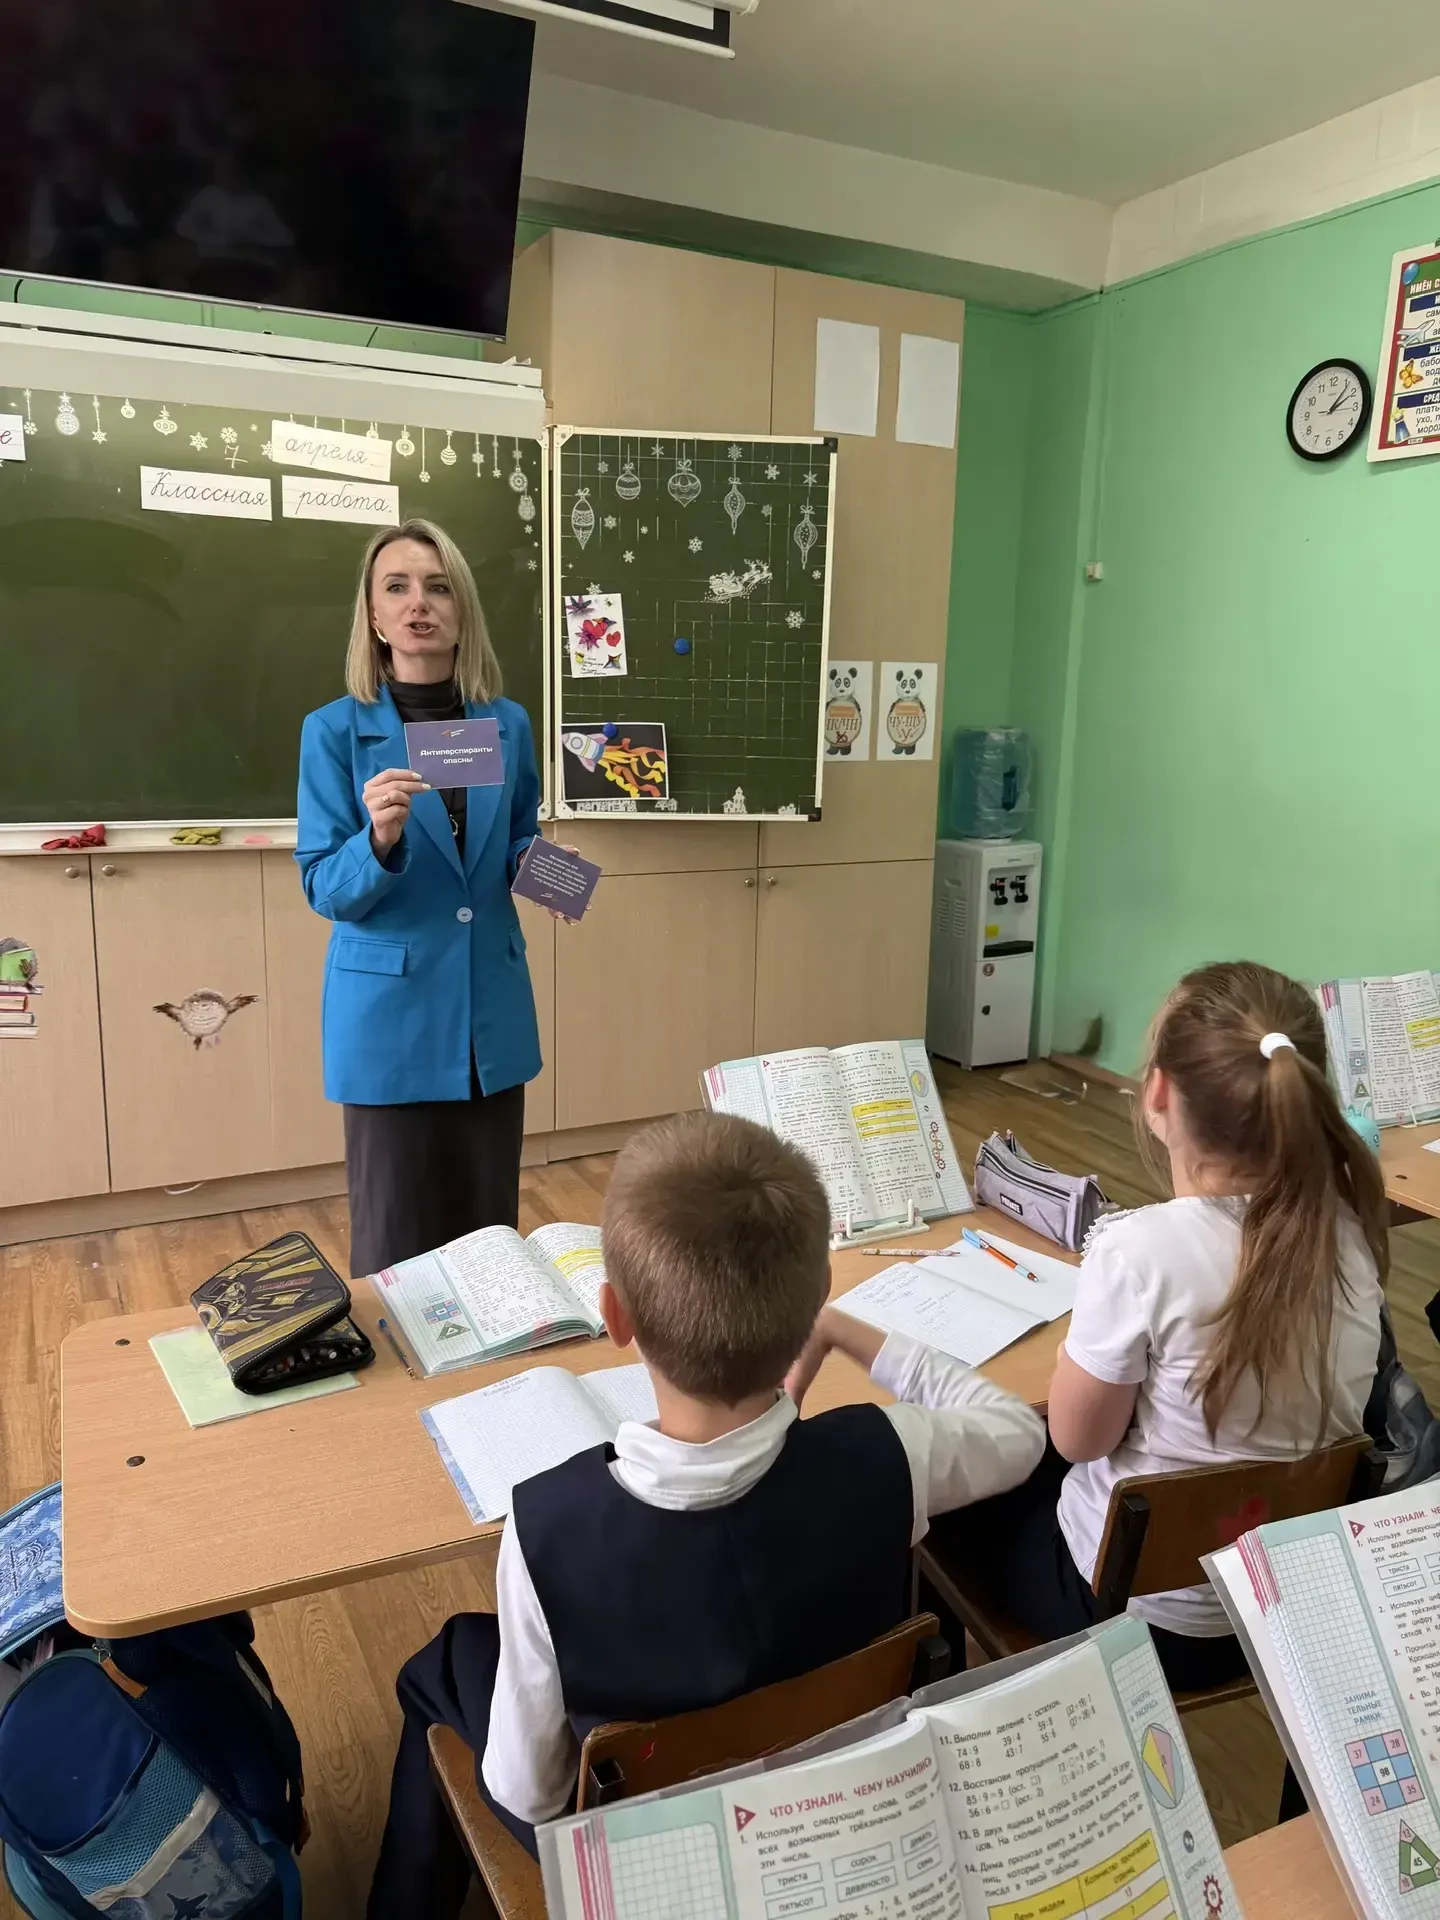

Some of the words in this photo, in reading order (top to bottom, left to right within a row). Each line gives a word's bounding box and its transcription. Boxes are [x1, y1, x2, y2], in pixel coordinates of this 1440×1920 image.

[1410, 280, 1432, 294] ИМЁН
[1434, 278, 1440, 288] С
[1429, 343, 1440, 354] ЖЕ
[1420, 357, 1440, 367] бабо
[1425, 367, 1440, 377] вод
[1329, 376, 1338, 387] 12
[1318, 384, 1325, 393] 11
[1350, 387, 1357, 397] 2
[1308, 396, 1316, 406] 10
[1423, 392, 1440, 404] СРЕД
[1352, 402, 1358, 411] 3
[1304, 411, 1310, 421] 9
[1416, 415, 1432, 427] ухо,
[1348, 417, 1353, 427] 4
[1306, 425, 1312, 435] 8
[1338, 430, 1344, 440] 5
[1314, 434, 1320, 444] 7
[1325, 436, 1331, 446] 6
[224, 445, 248, 469] 7
[151, 472, 268, 508] Классная
[420, 747, 493, 757] Антиперспиранты
[443, 757, 473, 765] опасны
[1374, 1517, 1391, 1529] ЧТО
[1391, 1510, 1428, 1525] УЗНАЛИ.
[1367, 1531, 1401, 1545] Используя
[1370, 1546, 1385, 1554] всех
[1390, 1535, 1428, 1550] возможных
[1388, 1564, 1410, 1576] триста
[1393, 1580, 1417, 1593] пятьсот
[1379, 1605, 1386, 1614] 2.
[1389, 1597, 1425, 1612] Используя
[1411, 1616, 1433, 1628] цифру
[1393, 1648, 1401, 1657] 3.
[1405, 1640, 1437, 1654] Прочитай
[1412, 1666, 1422, 1674] до
[1420, 1690, 1431, 1698] Во
[1347, 1699, 1383, 1716] ТЕЛЬНЫЕ
[939, 1736, 953, 1746] 11.
[953, 1729, 992, 1744] Выполни
[996, 1716, 1025, 1735] деление
[1027, 1713, 1032, 1721] с
[1390, 1739, 1401, 1749] 28
[1353, 1749, 1363, 1760] 37
[1380, 1767, 1390, 1778] 98
[949, 1782, 962, 1792] 12.
[963, 1772, 1012, 1791] Восстанови
[1407, 1784, 1417, 1795] 35
[769, 1803, 793, 1818] ЧТО
[797, 1792, 847, 1815] УЗНАЛИ.
[853, 1781, 883, 1798] ЧЕМУ
[1371, 1796, 1381, 1807] 24
[739, 1834, 748, 1844] 1.
[755, 1823, 804, 1841] Используя
[813, 1807, 865, 1828] следующие
[758, 1845, 779, 1856] всех
[787, 1829, 840, 1849] возможных
[850, 1810, 902, 1833] трёхзначных
[958, 1831, 972, 1840] 13.
[972, 1828, 980, 1838] В
[1403, 1828, 1411, 1838] 13
[997, 1836, 1010, 1847] На
[760, 1859, 775, 1870] эти
[850, 1854, 877, 1870] сорок
[964, 1864, 978, 1874] 14.
[980, 1860, 1004, 1873] Дима
[1413, 1856, 1423, 1867] 45
[778, 1871, 808, 1887] триста
[845, 1874, 890, 1896] девяносто
[779, 1896, 814, 1912] пятьсот
